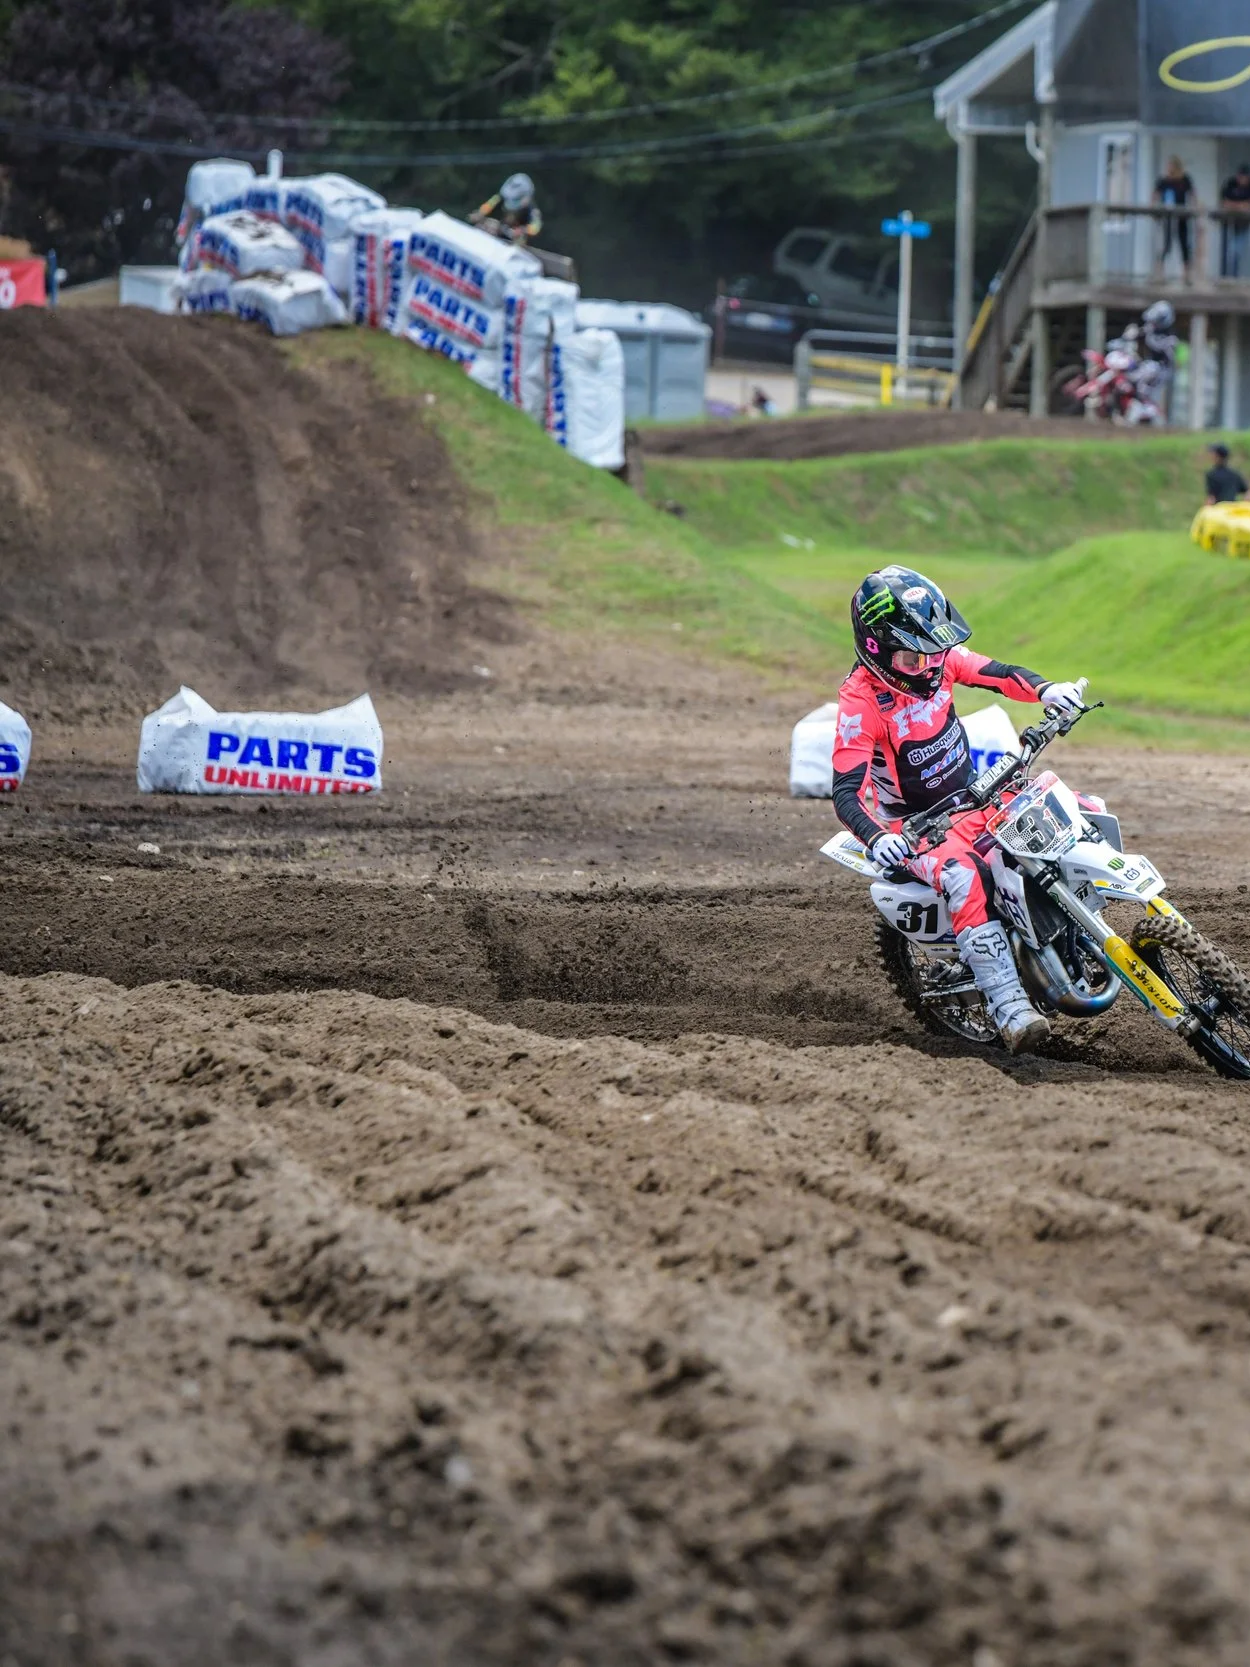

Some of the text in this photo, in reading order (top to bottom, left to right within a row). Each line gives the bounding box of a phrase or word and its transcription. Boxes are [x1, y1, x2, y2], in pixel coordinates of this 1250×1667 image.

[410, 232, 485, 289] PARTS
[414, 275, 490, 335] PARTS
[206, 730, 377, 779] PARTS
[204, 765, 373, 795] UNLIMITED
[833, 852, 855, 866] DUNLOP
[896, 901, 938, 934] 31
[1136, 970, 1174, 1011] DUNLOP
